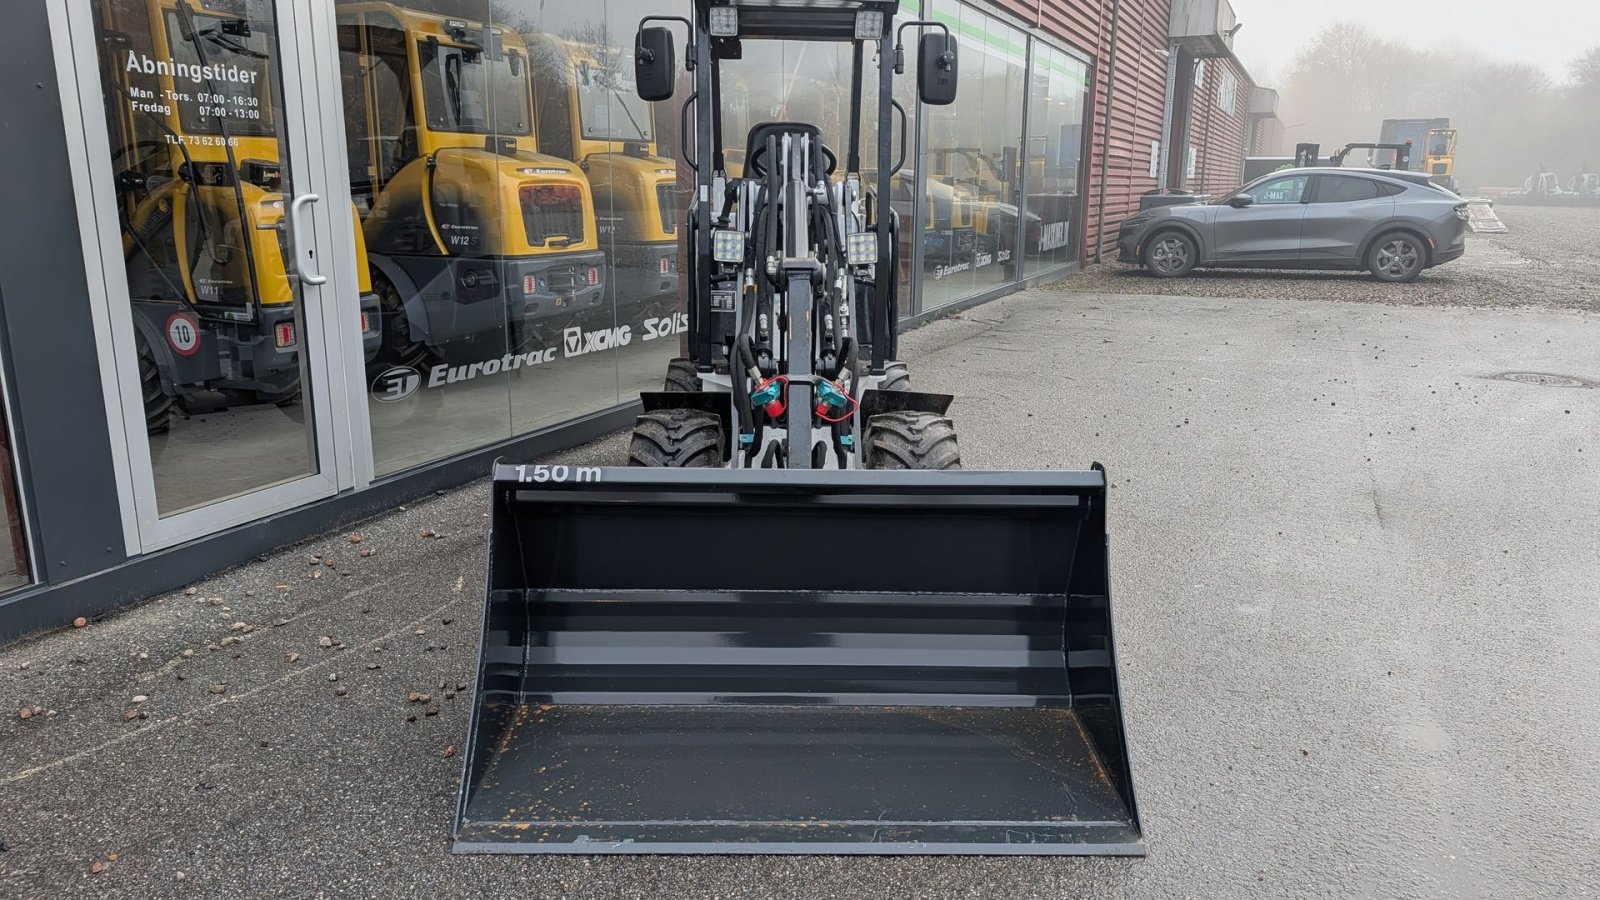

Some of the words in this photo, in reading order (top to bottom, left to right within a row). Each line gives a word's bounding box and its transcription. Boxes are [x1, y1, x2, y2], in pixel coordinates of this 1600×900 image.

[126, 50, 258, 84] Åbningstider
[130, 87, 154, 99] Man
[197, 93, 225, 104] 07:00
[232, 96, 258, 107] 16:30
[132, 101, 171, 116] Fredag
[199, 106, 226, 117] 07:00
[234, 108, 260, 119] 13:00
[175, 325, 191, 343] 10
[428, 347, 557, 388] Eurotrac
[582, 324, 632, 354] XCMG
[642, 312, 689, 341] Solis
[515, 464, 569, 483] 1.50
[575, 466, 602, 483] m
